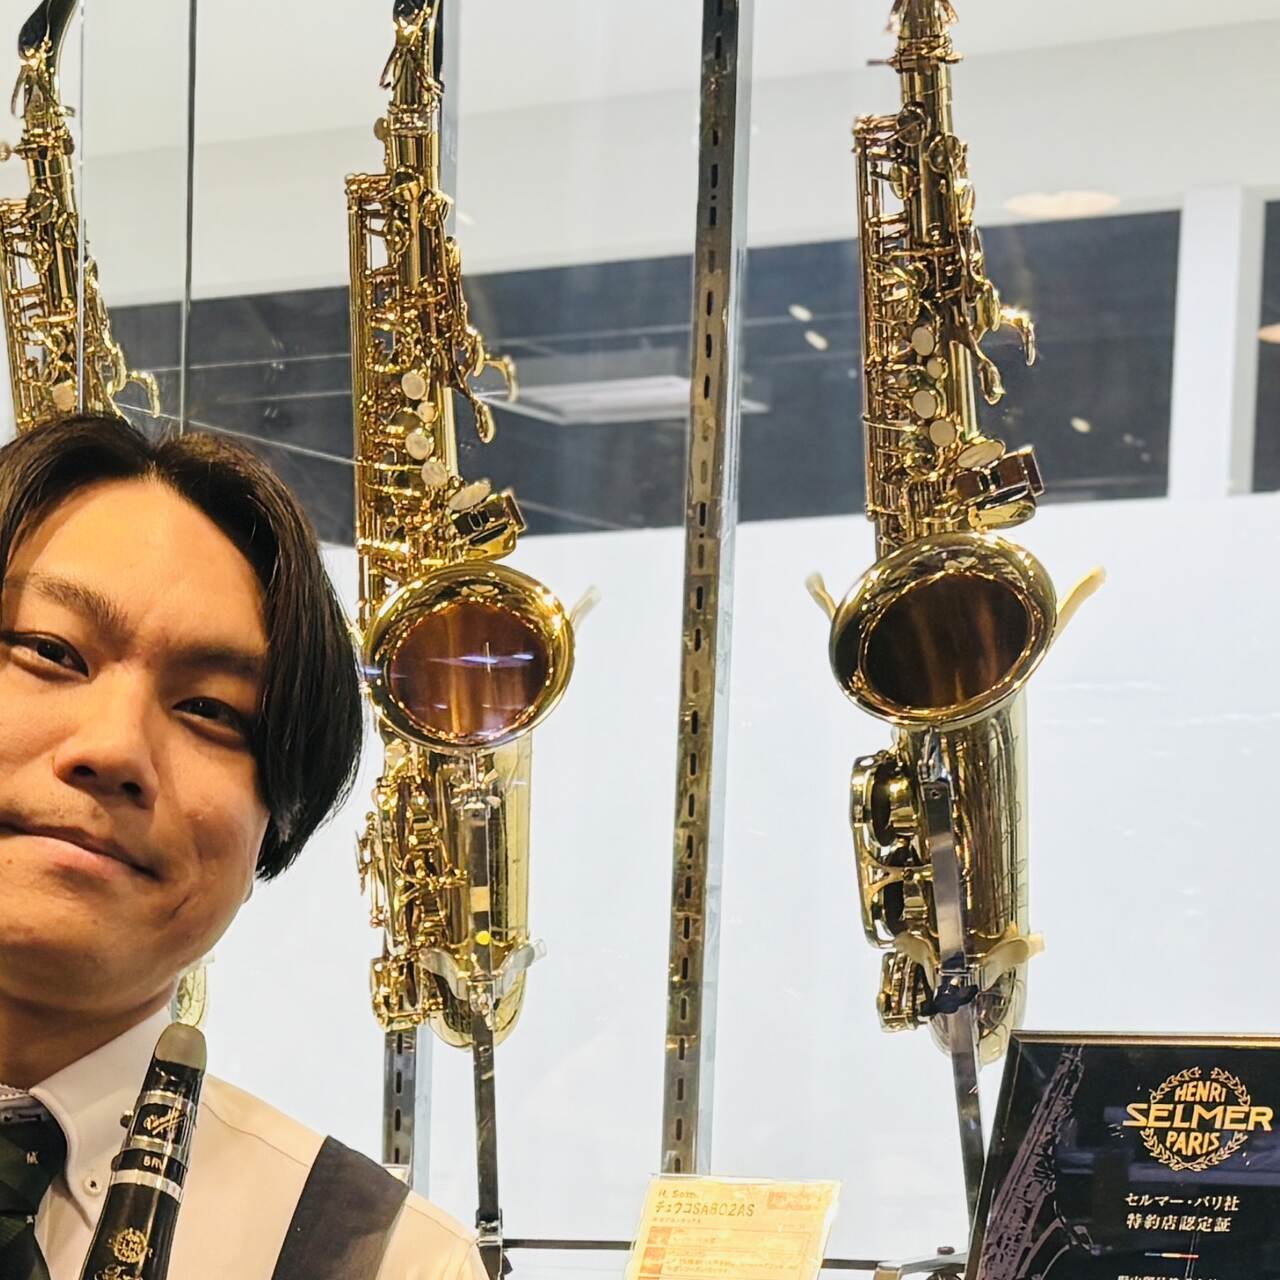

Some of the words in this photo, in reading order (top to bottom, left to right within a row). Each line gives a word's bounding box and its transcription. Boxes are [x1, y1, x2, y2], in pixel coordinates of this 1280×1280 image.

[1174, 1080, 1227, 1103] HENRI
[1122, 1102, 1274, 1132] SELMER
[1165, 1131, 1221, 1157] PARIS
[1124, 1192, 1241, 1212] セルマー・パリ社
[1126, 1212, 1233, 1233] 特約店認定証
